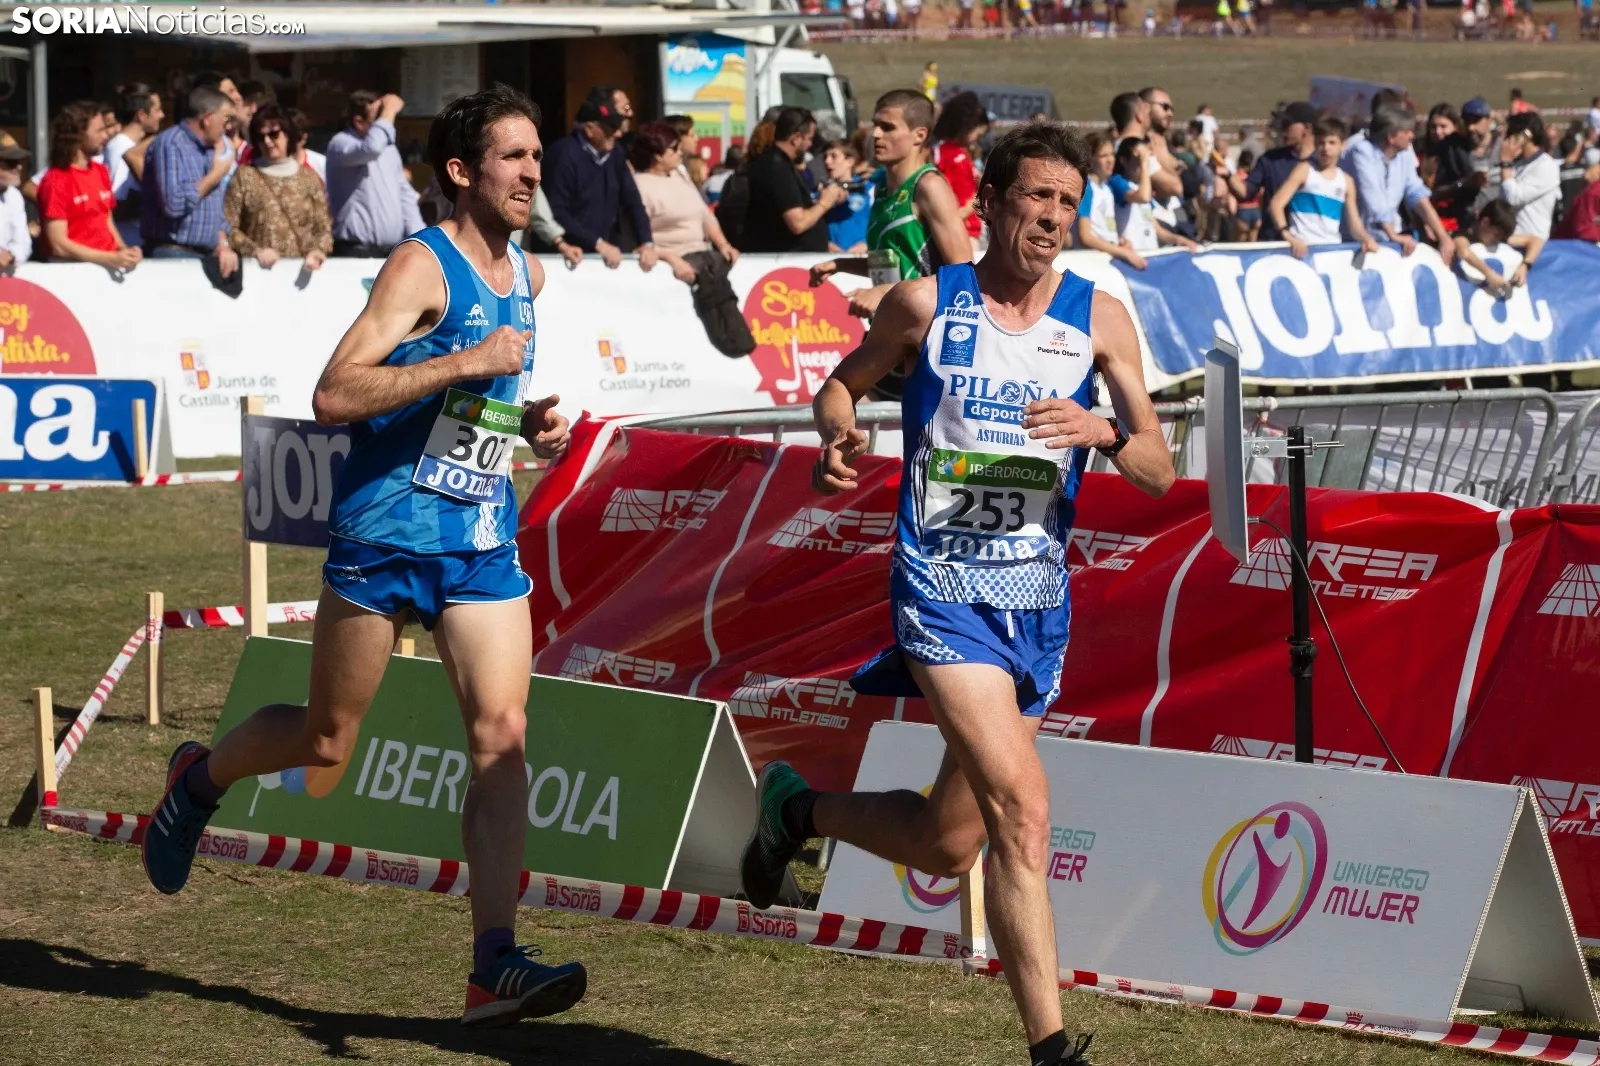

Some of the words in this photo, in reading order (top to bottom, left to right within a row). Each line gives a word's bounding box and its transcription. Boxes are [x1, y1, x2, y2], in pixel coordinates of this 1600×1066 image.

[761, 280, 815, 317] Soy
[944, 308, 979, 320] VIATOR
[1037, 346, 1060, 356] Puerta
[1061, 349, 1081, 358] Otero
[634, 361, 669, 373] Junta
[215, 375, 256, 389] Junta
[260, 376, 278, 388] de
[600, 378, 646, 391] Castilla
[659, 377, 691, 389] León
[179, 394, 229, 408] Castilla
[970, 402, 1031, 421] deport
[976, 428, 1026, 447] ASTURIAS
[969, 463, 1048, 483] IBERDROLA
[947, 487, 1026, 532] 253
[1307, 540, 1439, 581] RFEA
[594, 651, 676, 685] RFEA
[772, 677, 857, 708] RFEA
[770, 705, 850, 730] ATLETISMO
[354, 736, 621, 841] IBEROLA
[210, 835, 248, 860] Soria
[379, 859, 419, 886] Soria
[1332, 860, 1430, 892] UNIVERSO
[558, 885, 601, 912] Soria
[1322, 885, 1420, 925] MUJER
[752, 911, 797, 938] Soria
